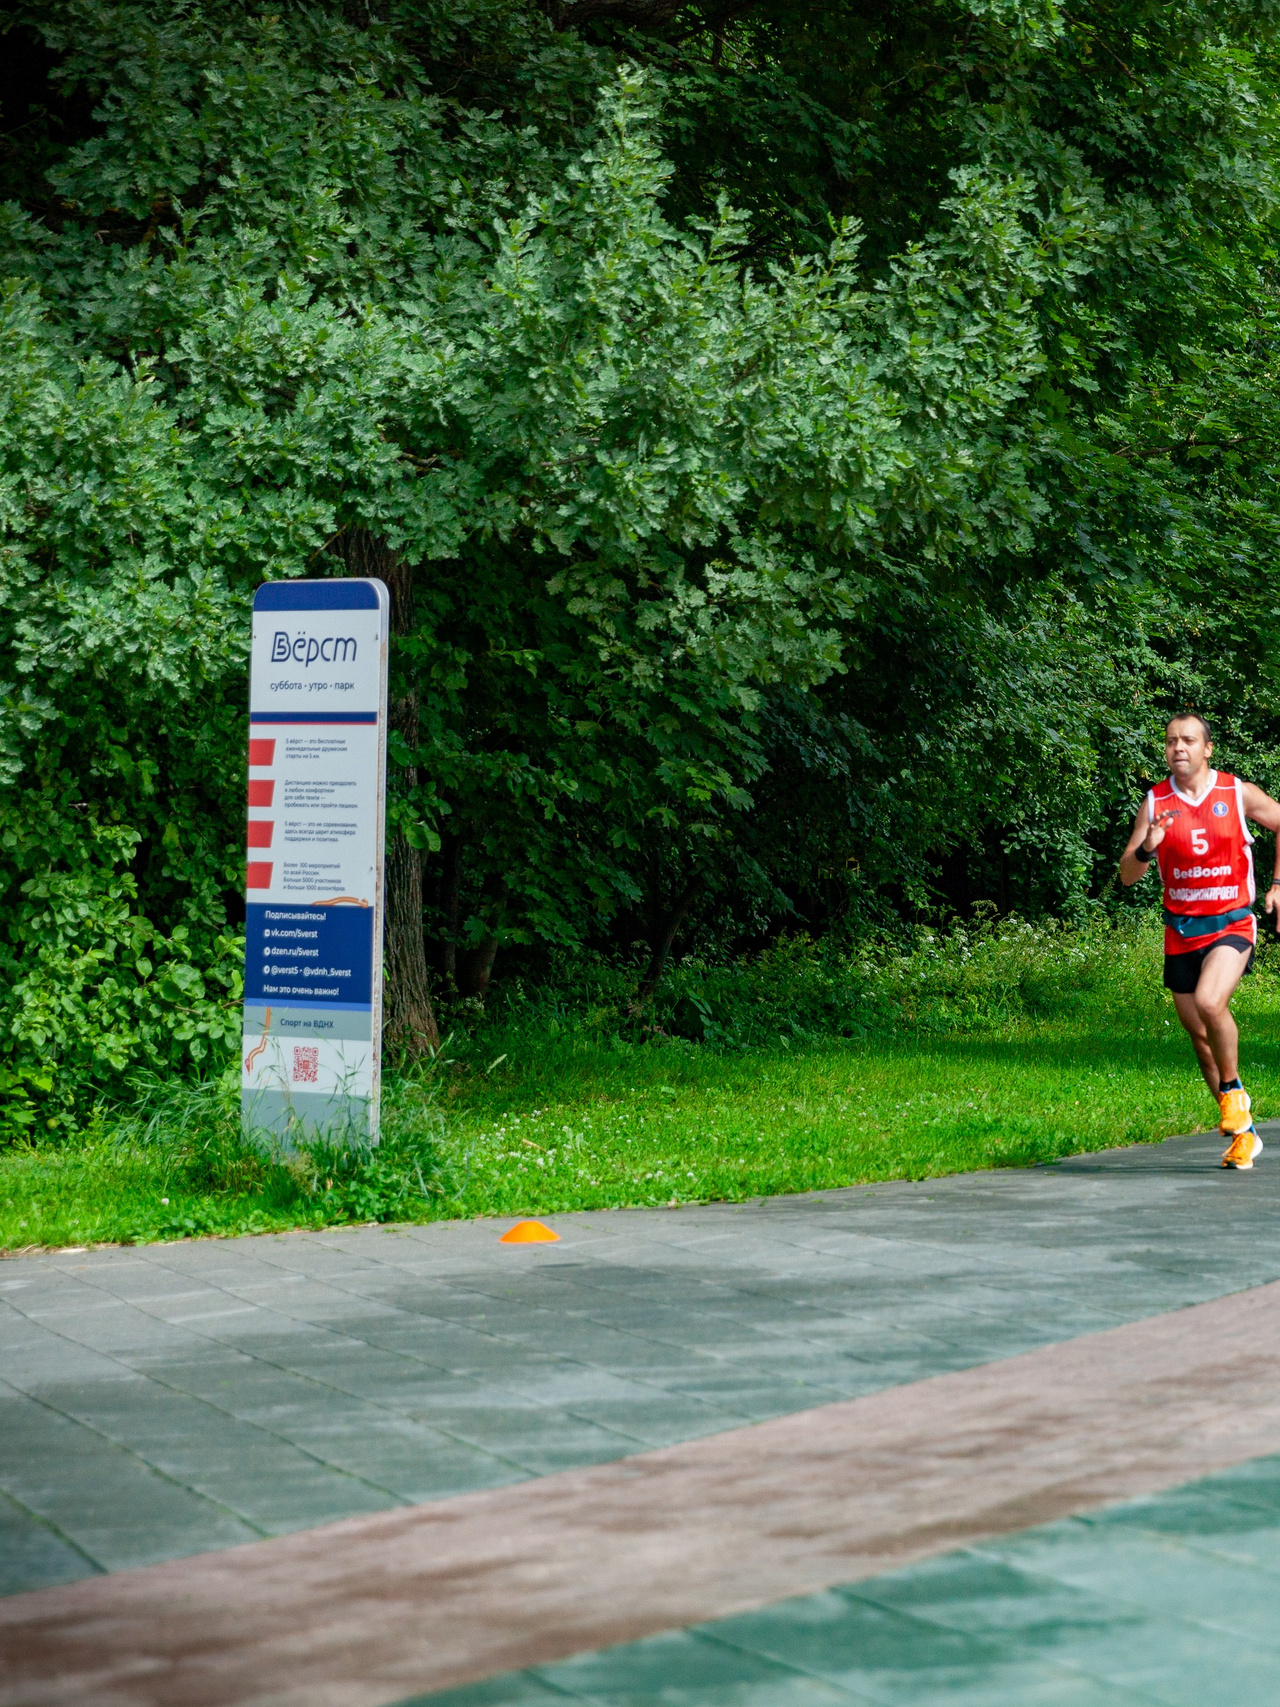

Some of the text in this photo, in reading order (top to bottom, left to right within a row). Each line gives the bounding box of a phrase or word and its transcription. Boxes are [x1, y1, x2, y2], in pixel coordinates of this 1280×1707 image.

[270, 681, 355, 691] суббота утро парк
[1191, 828, 1209, 855] 5
[1173, 865, 1231, 879] BetBoom
[265, 910, 326, 921] Подписывайтесь!
[271, 929, 318, 939] vk.com/5verst
[271, 947, 319, 957] dzen.ru/5verst
[271, 966, 351, 977] @verst5 @vdnh_5verst
[264, 985, 339, 996] Нам это очень важно!
[280, 1018, 301, 1028] Спорт
[314, 1020, 334, 1029] ВДНХ
